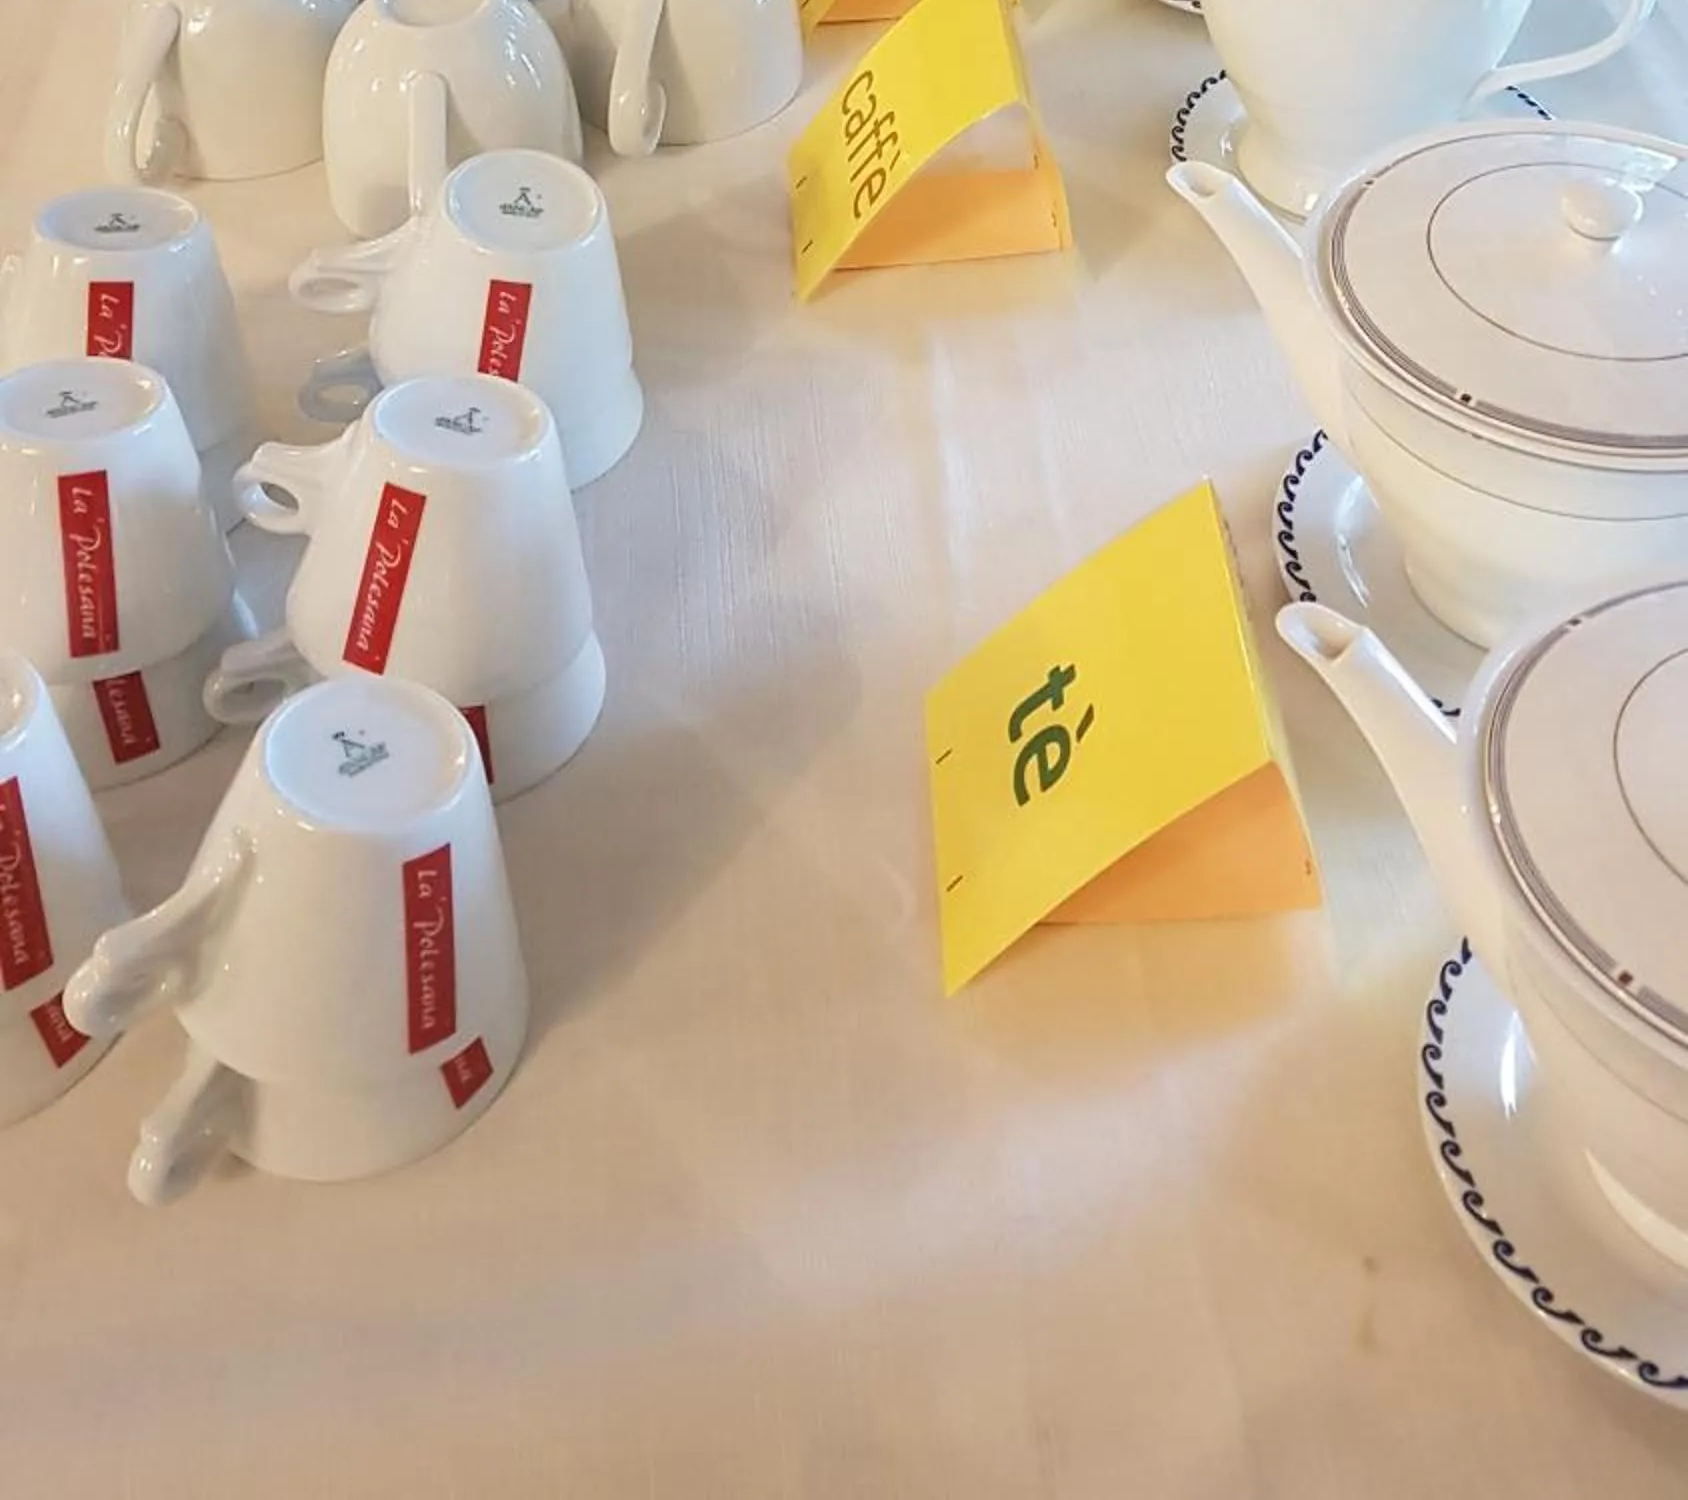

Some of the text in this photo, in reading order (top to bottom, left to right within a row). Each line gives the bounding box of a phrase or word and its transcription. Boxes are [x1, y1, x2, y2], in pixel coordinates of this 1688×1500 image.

[842, 70, 901, 218] caffè
[99, 293, 120, 319] La
[498, 291, 517, 314] La
[69, 487, 102, 639] La Polesana
[356, 499, 408, 652] La Polesana
[1008, 663, 1095, 807] tè
[412, 870, 445, 1030] La Polesana
